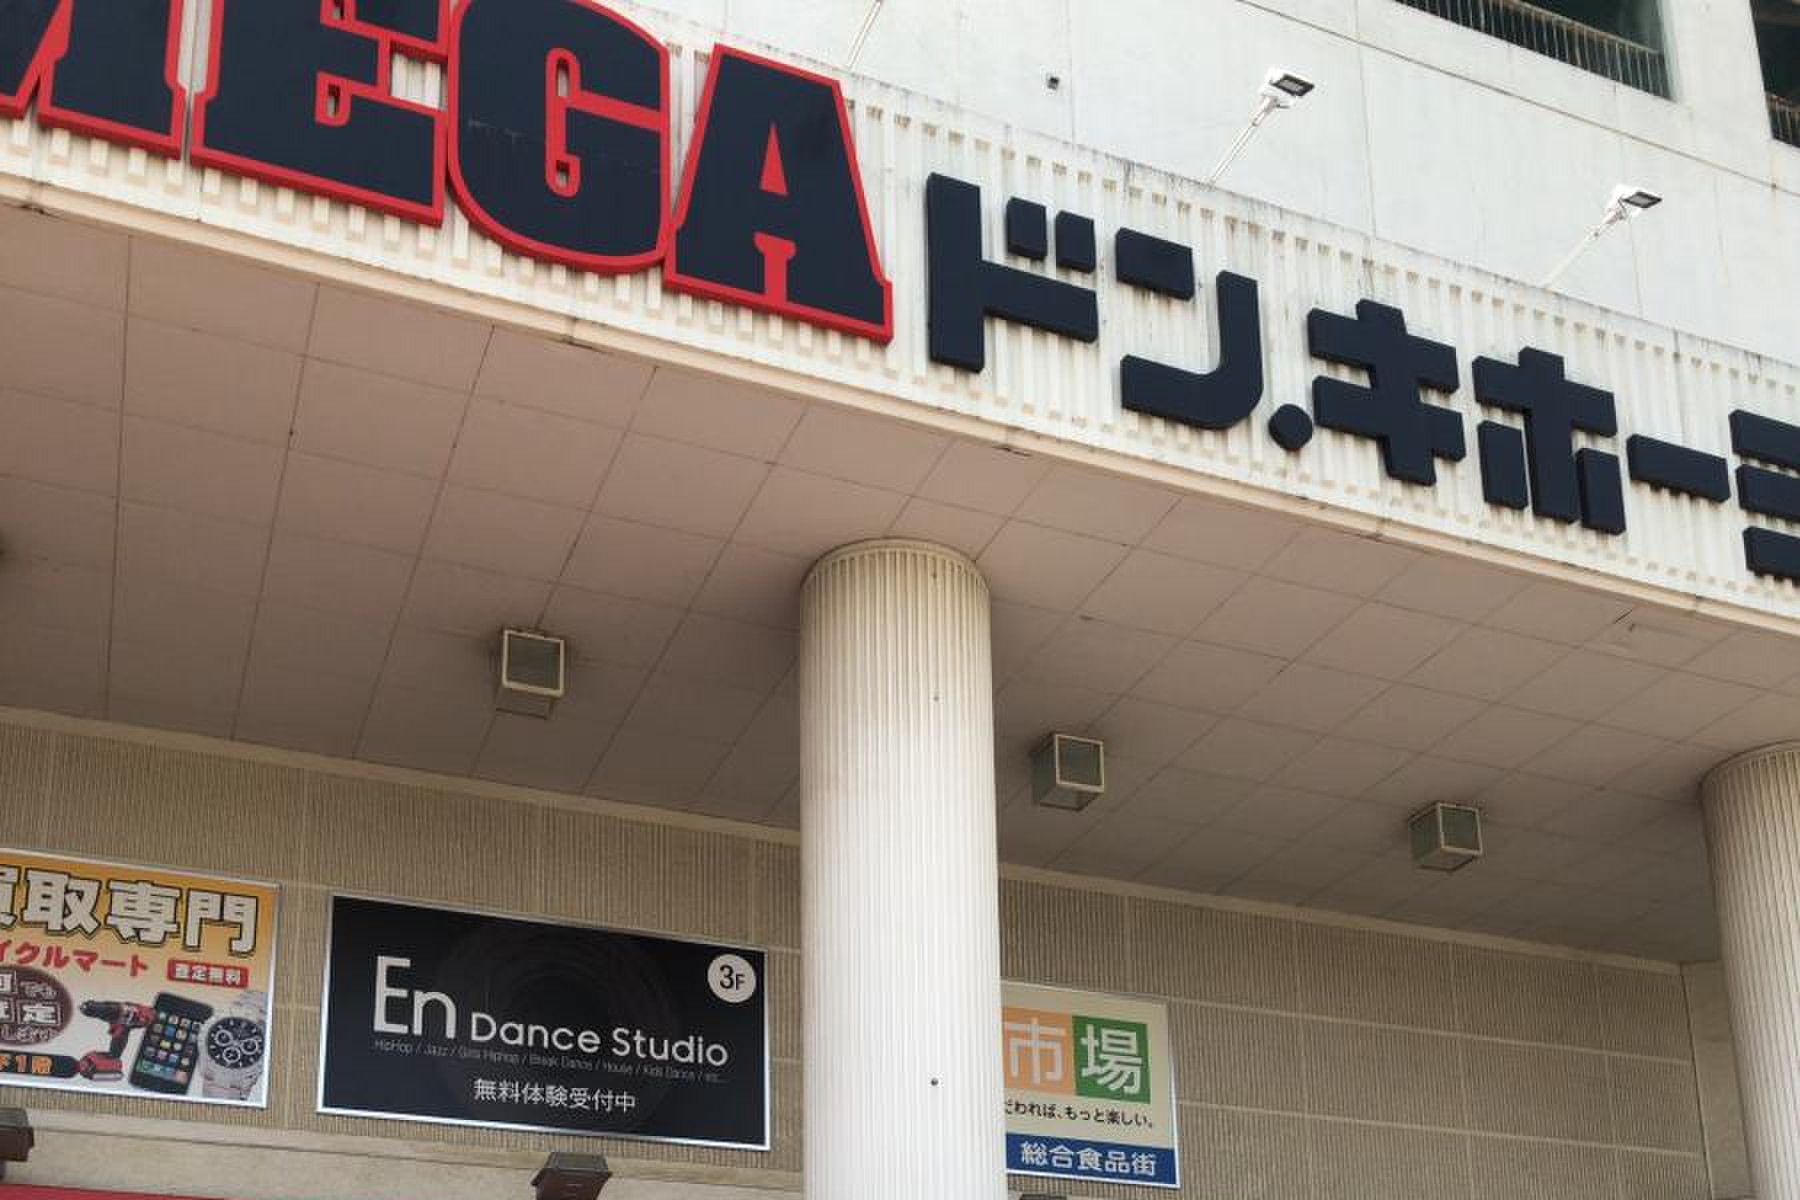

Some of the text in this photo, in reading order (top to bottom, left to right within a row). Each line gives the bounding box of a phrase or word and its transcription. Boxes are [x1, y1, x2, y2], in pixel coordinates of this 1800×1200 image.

[0, 864, 258, 957] 取専門
[718, 964, 746, 992] 3F
[373, 955, 729, 1067] En Dance Studio
[1004, 1018, 1142, 1095] 市場
[473, 1078, 635, 1111] 無料体験受付中
[1021, 1141, 1157, 1176] 総合食品街
